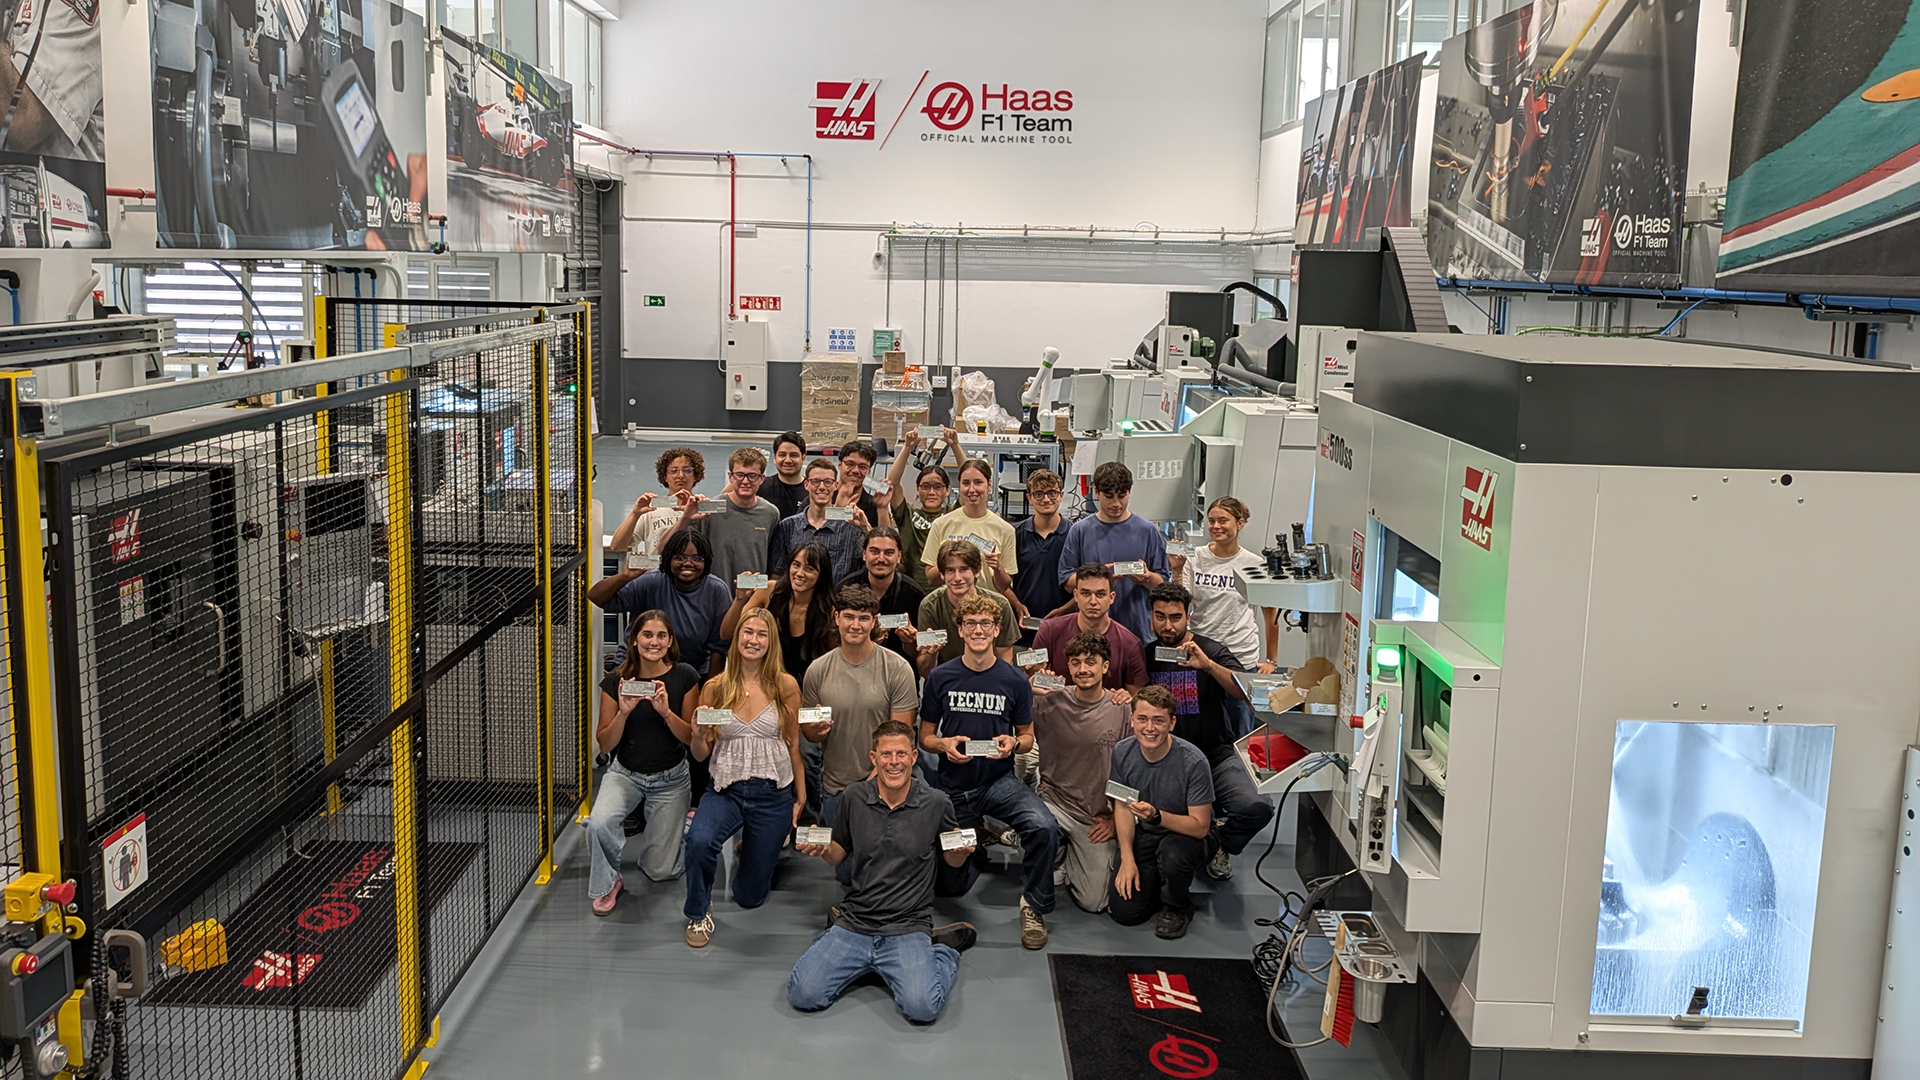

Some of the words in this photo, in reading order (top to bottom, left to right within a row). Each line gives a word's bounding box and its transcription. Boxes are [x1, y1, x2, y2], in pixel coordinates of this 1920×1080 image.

[982, 84, 1073, 111] Haas
[816, 119, 875, 136] HAAS
[982, 114, 1003, 131] F1
[1015, 114, 1072, 132] Team
[921, 133, 975, 143] OFFICIAL
[982, 135, 1035, 144] MACHINE
[1042, 136, 1072, 144] TOOL
[402, 198, 421, 213] Haas
[1635, 214, 1671, 234] Haas
[1633, 235, 1642, 248] F1
[1643, 236, 1668, 248] Team
[652, 516, 674, 531] PINK
[1461, 518, 1492, 545] HAAS
[1195, 571, 1235, 588] TECNU
[948, 690, 1006, 711] TECNUN
[1131, 973, 1155, 1009] HAAS
